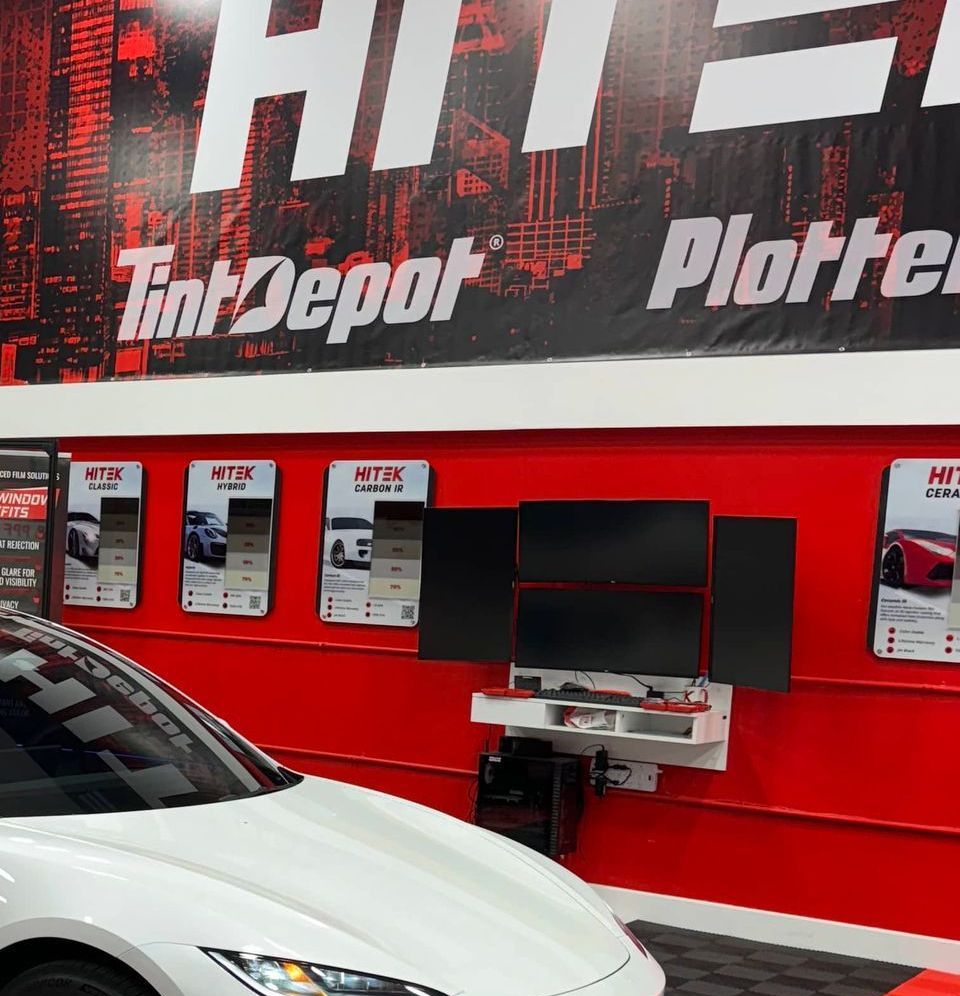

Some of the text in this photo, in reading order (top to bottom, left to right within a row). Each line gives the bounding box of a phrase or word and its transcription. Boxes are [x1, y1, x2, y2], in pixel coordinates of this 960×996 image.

[190, 0, 960, 193] HIT
[117, 236, 486, 344] TintDepot
[12, 471, 26, 480] FILM
[27, 471, 60, 481] SOLUTIS
[85, 467, 124, 481] HITEK
[211, 465, 256, 480] HITEK
[355, 465, 406, 482] HITEK
[88, 482, 118, 491] CLASSIC
[217, 482, 246, 491] HYBRID
[355, 484, 404, 493] CARBON IR
[7, 540, 39, 551] REJECTION
[1, 567, 21, 577] GLARE
[22, 568, 35, 578] FOR
[5, 577, 37, 588] VISIBILITY
